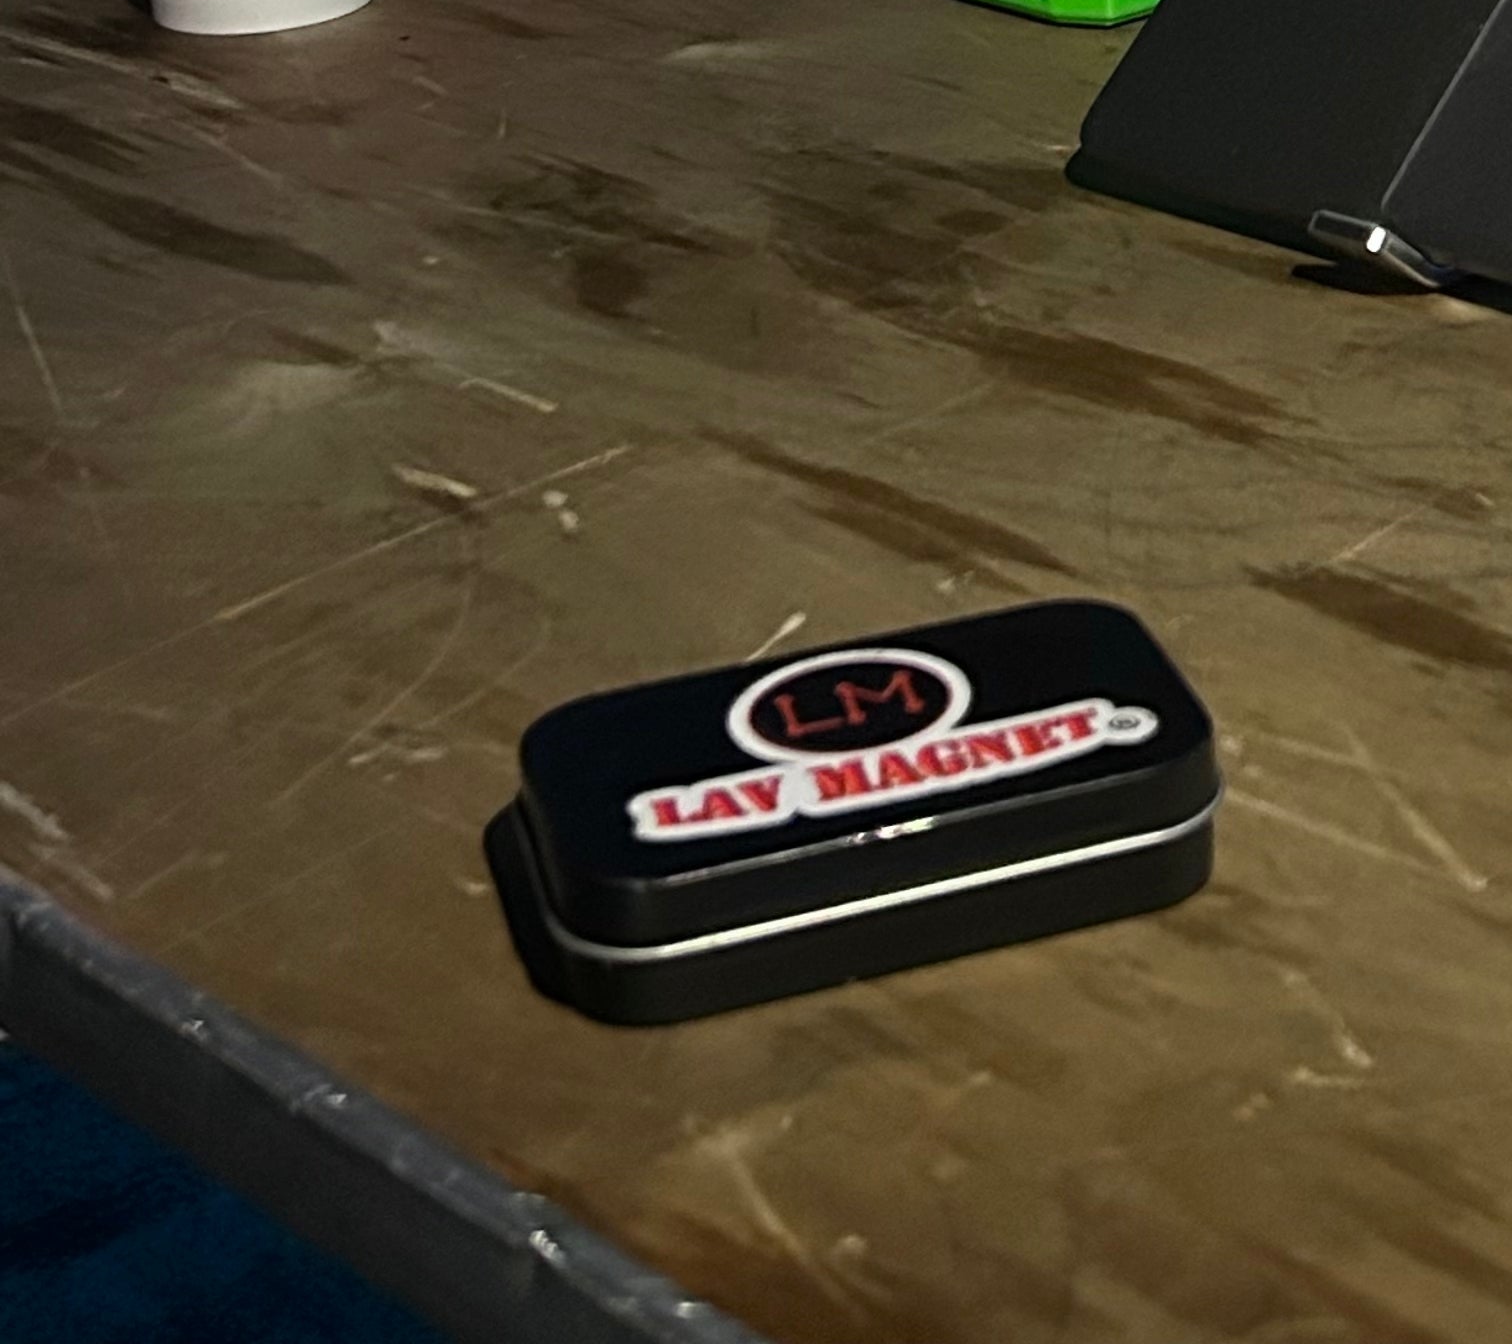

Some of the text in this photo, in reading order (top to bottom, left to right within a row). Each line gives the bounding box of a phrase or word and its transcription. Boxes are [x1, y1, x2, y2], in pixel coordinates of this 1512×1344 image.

[772, 668, 925, 738] LM
[653, 708, 1100, 828] LAV MAGNET
